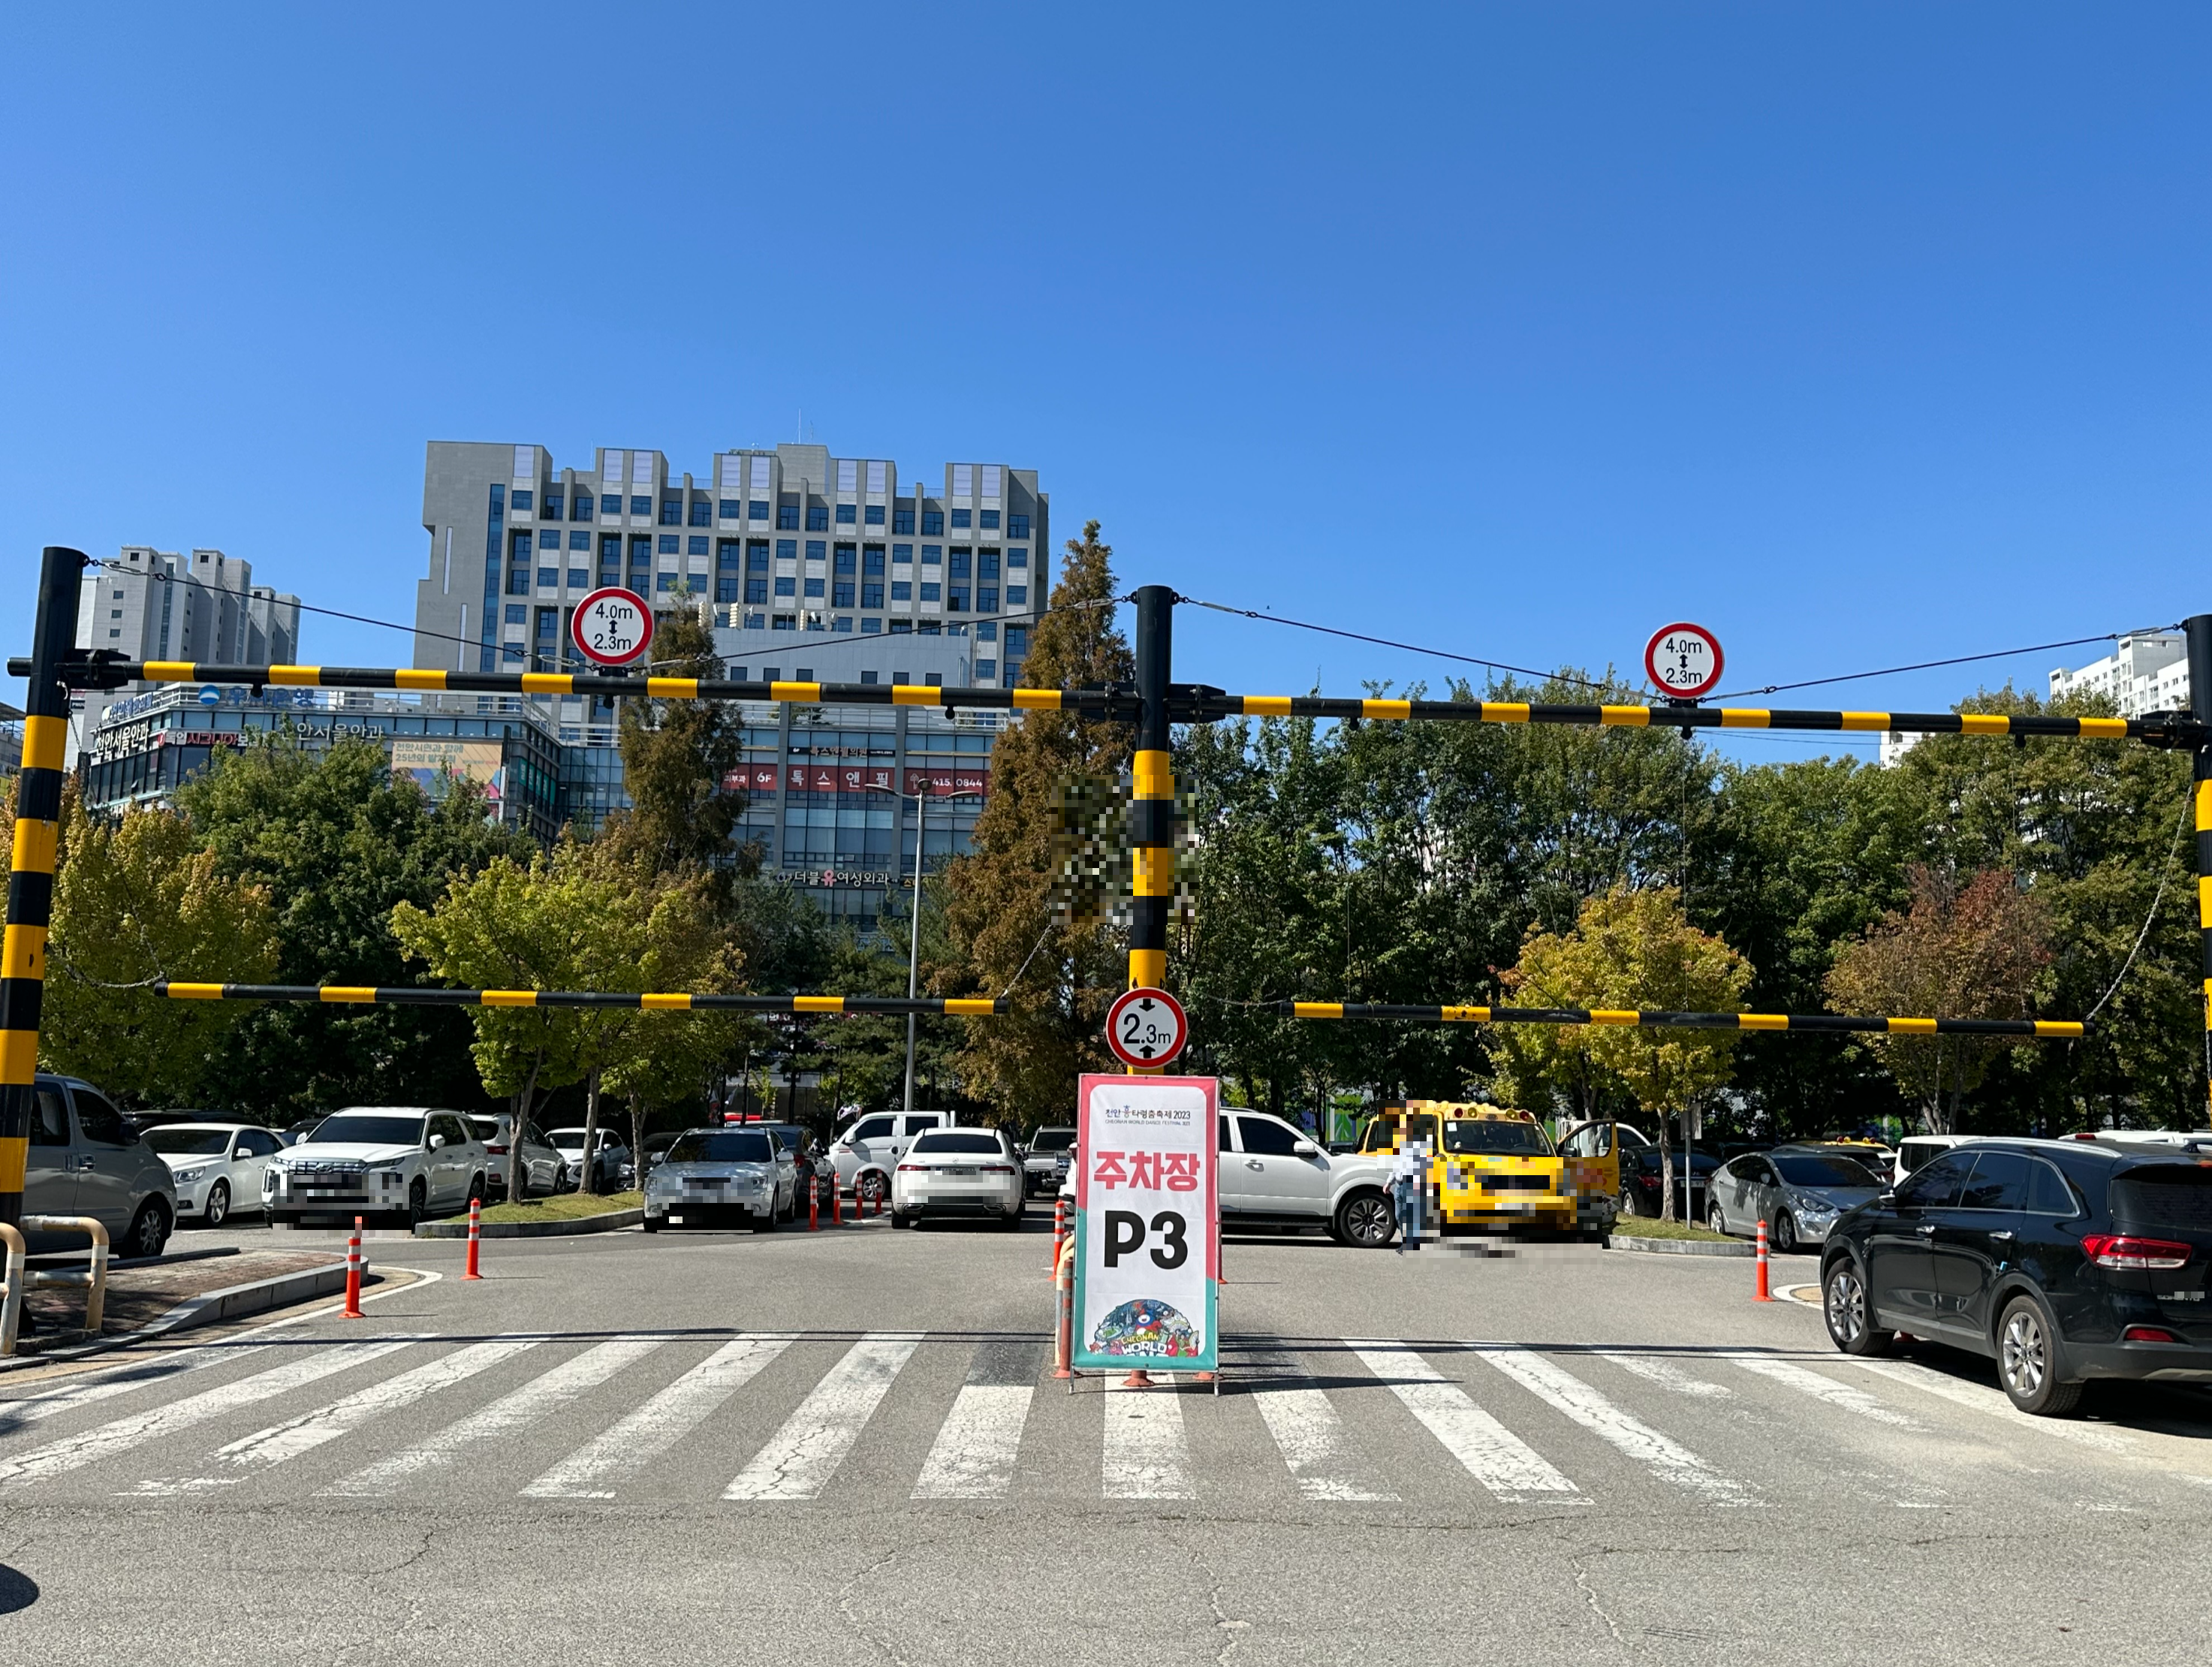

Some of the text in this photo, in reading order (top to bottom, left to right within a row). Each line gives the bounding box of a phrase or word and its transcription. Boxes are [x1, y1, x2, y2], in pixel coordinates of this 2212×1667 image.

[595, 602, 632, 619] 4.0m
[594, 633, 631, 650] 2.3m
[1665, 638, 1701, 653] 4.0m
[1666, 668, 1702, 683] 2.3m
[96, 721, 149, 757] 천안서울안과
[396, 743, 441, 752] 천안시민과
[396, 753, 425, 763] 25년의
[757, 772, 771, 782] 6F
[956, 778, 982, 787] 0844
[1123, 1013, 1171, 1044] 2.3m
[1094, 1151, 1200, 1192] 주차장
[1104, 1210, 1188, 1270] P3
[1121, 1332, 1159, 1345] CHEONAN
[1122, 1341, 1167, 1355] WORLD
